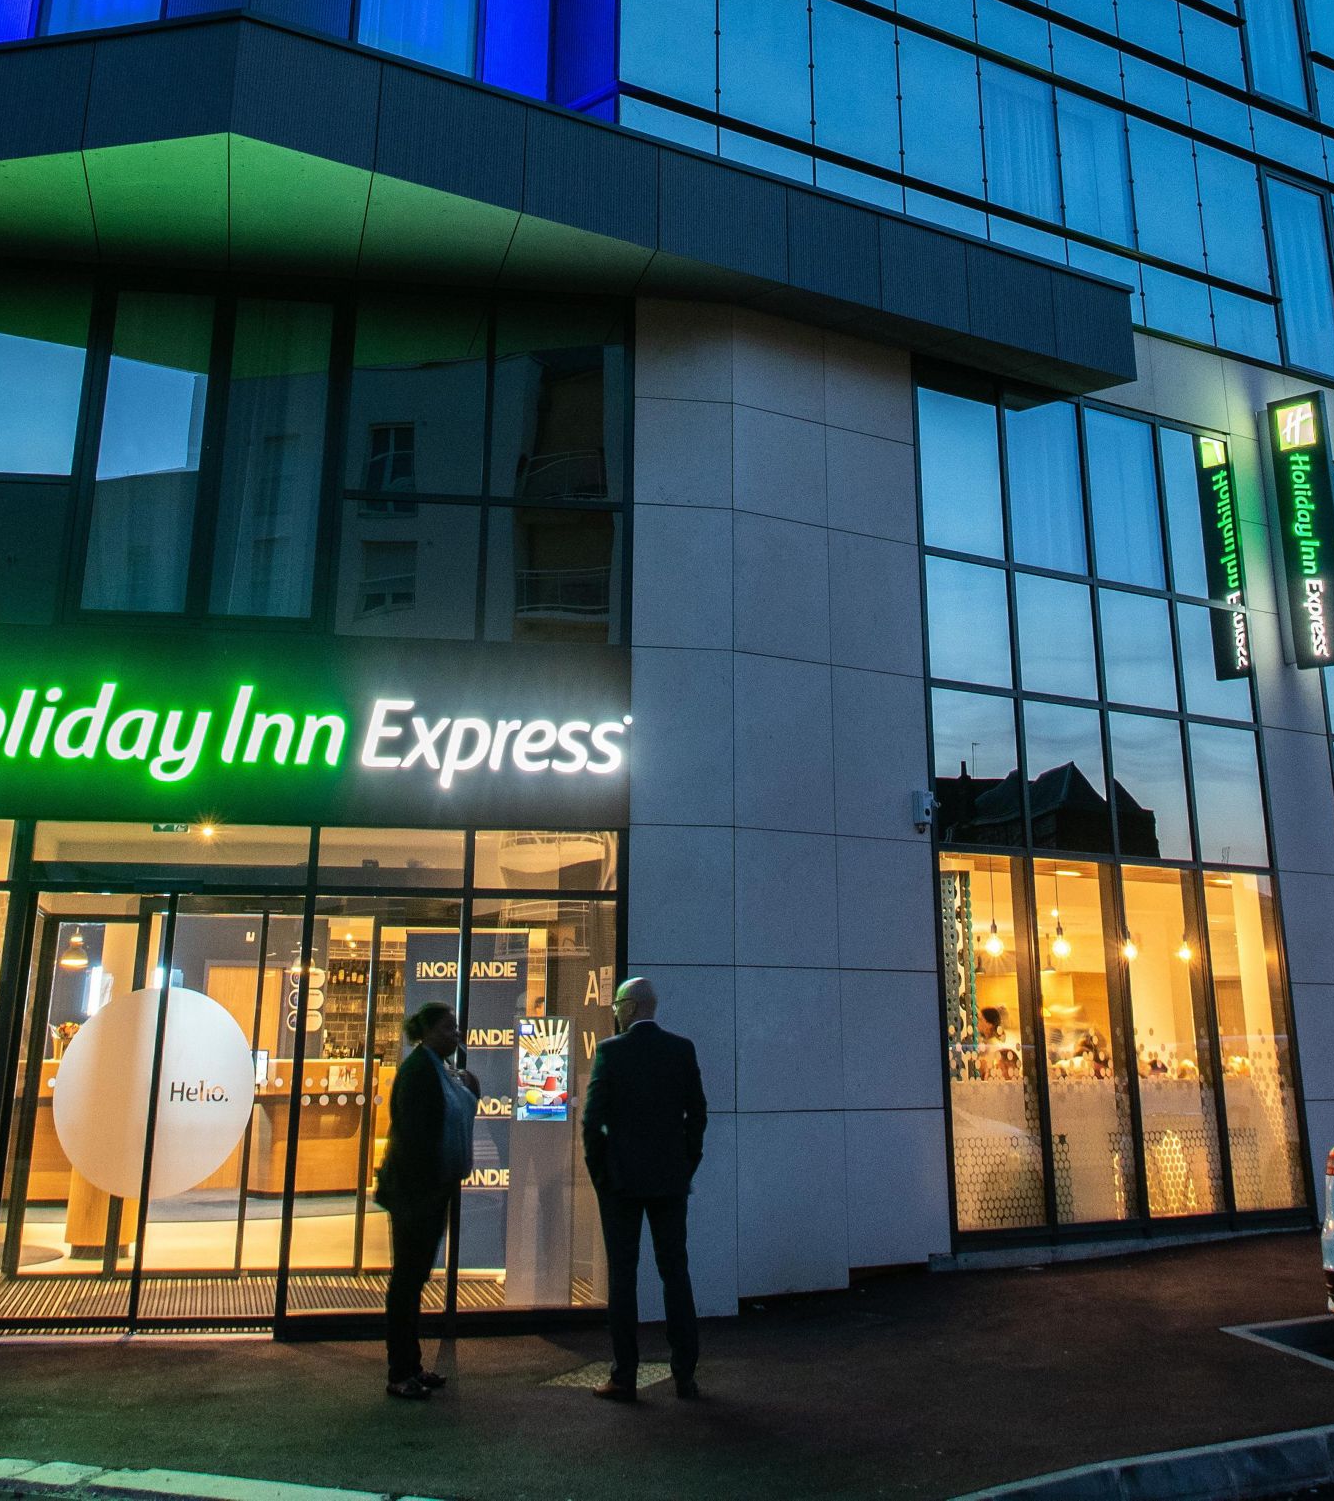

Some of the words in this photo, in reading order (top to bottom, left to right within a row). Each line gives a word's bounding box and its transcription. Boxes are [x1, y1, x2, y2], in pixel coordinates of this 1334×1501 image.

[1290, 452, 1316, 538] Holiday
[1300, 539, 1321, 576] Inn
[1303, 578, 1328, 657] Express
[220, 684, 346, 767] Inn
[360, 699, 622, 788] Express
[422, 962, 517, 978] NORANDIE
